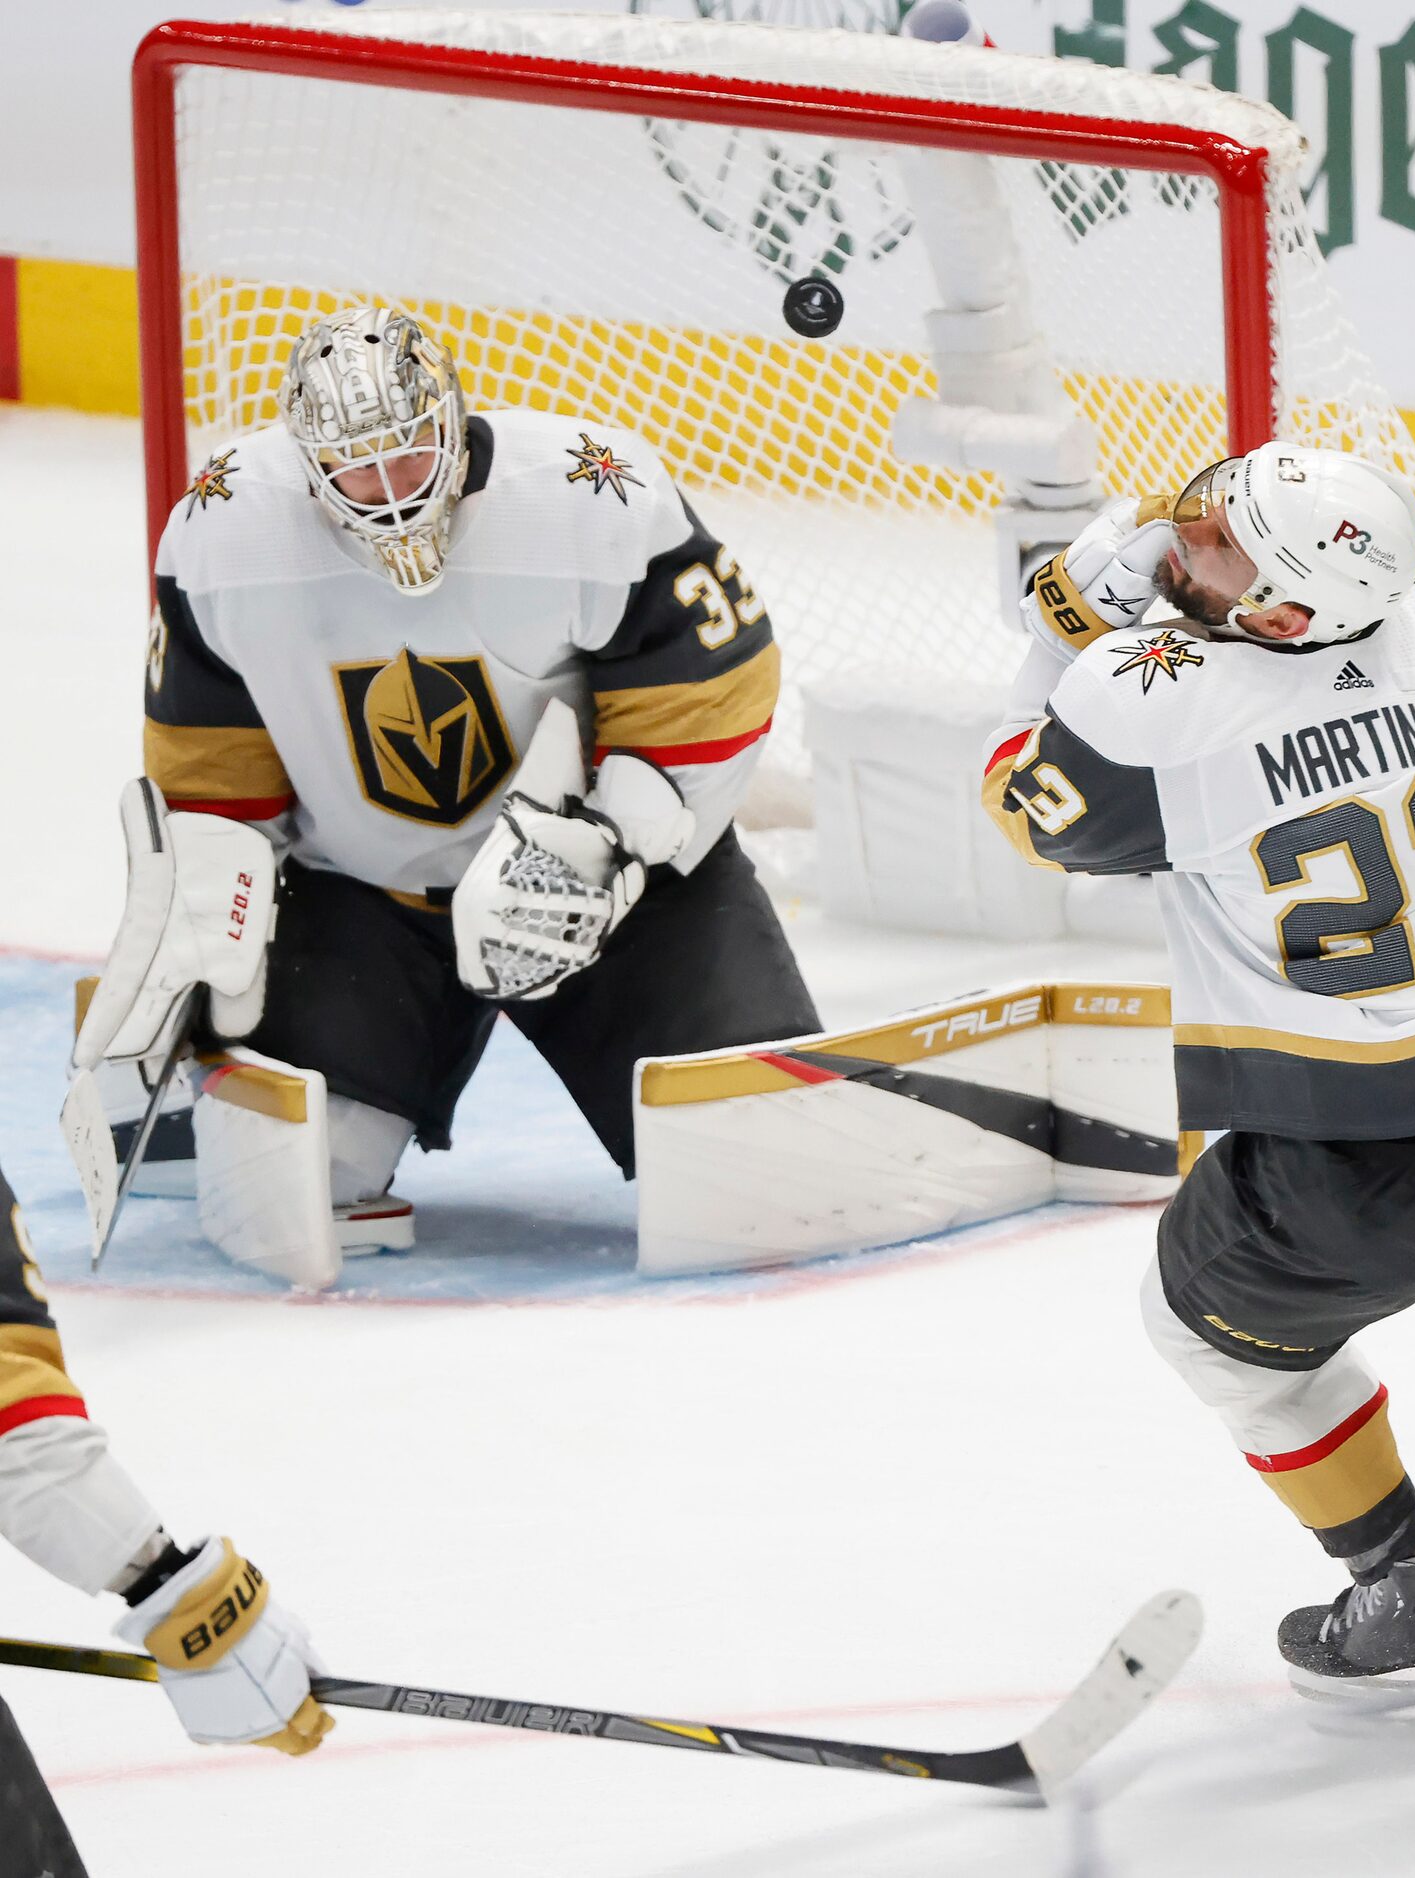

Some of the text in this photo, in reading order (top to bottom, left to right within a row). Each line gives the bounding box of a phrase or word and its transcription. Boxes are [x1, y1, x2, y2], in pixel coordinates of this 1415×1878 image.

[1332, 519, 1372, 555] P3
[1364, 552, 1398, 573] Partners
[1369, 544, 1397, 563] Health
[673, 543, 768, 651] 33
[1333, 677, 1375, 691] adidas
[227, 871, 254, 941] L20.2
[1073, 996, 1143, 1016] L20.2
[910, 995, 1043, 1049] TRUE
